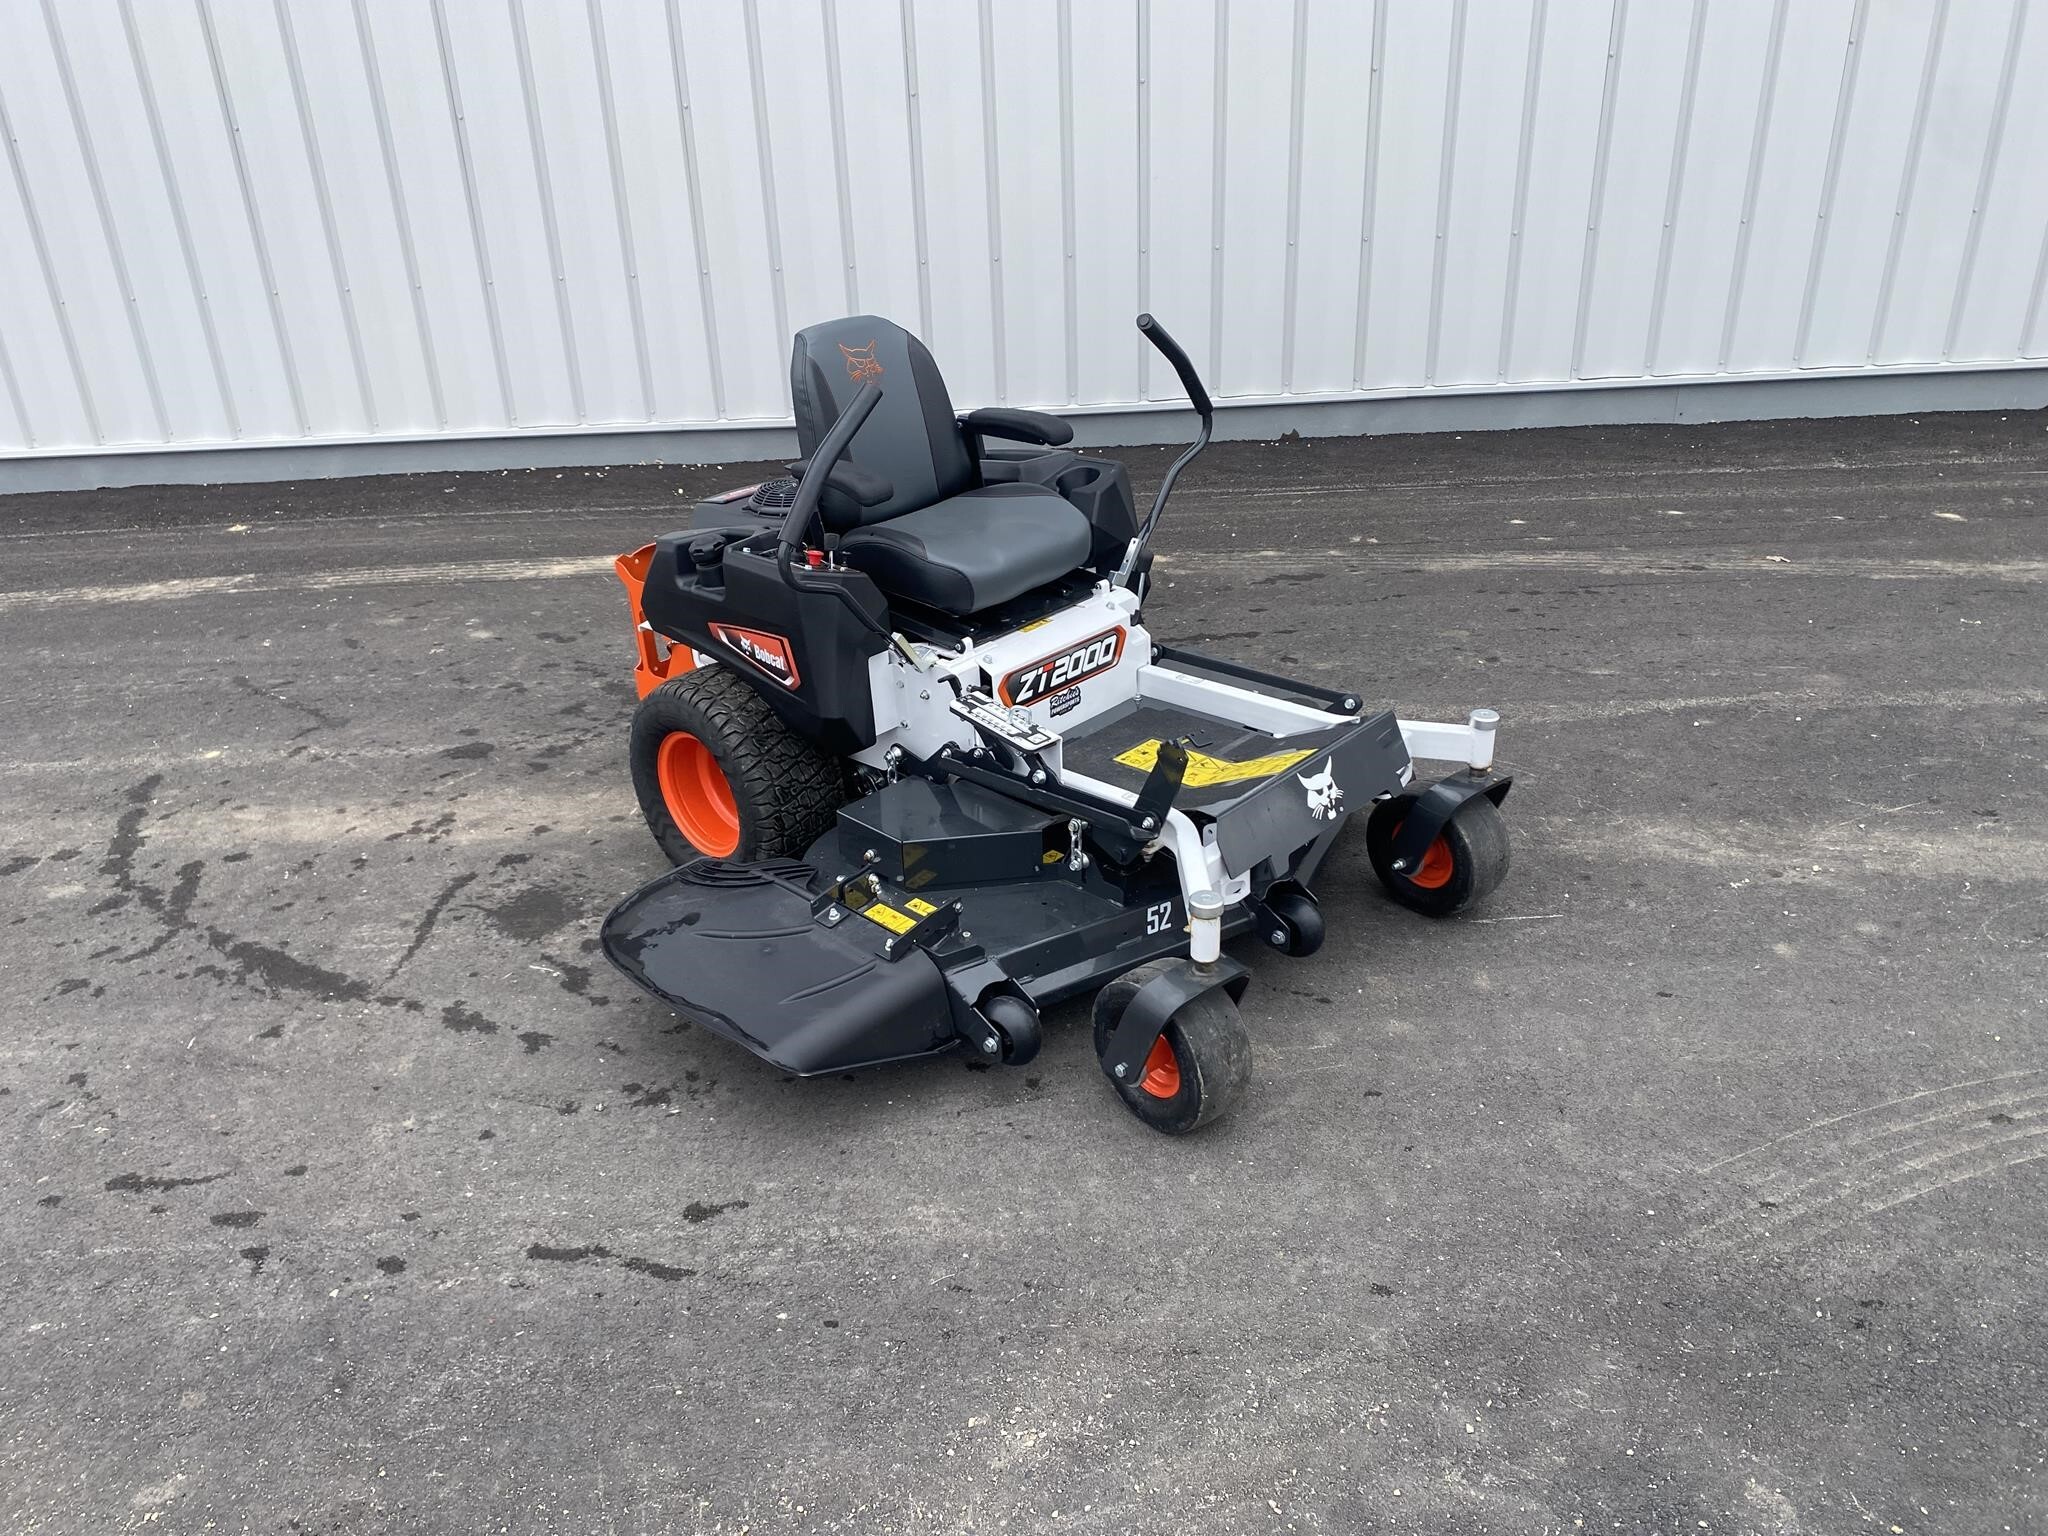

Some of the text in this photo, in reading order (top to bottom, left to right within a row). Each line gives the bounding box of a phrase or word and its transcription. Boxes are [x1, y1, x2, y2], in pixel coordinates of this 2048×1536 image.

[753, 643, 785, 671] Bobcat
[1015, 634, 1117, 703] ZT2000
[1147, 901, 1172, 935] 52
